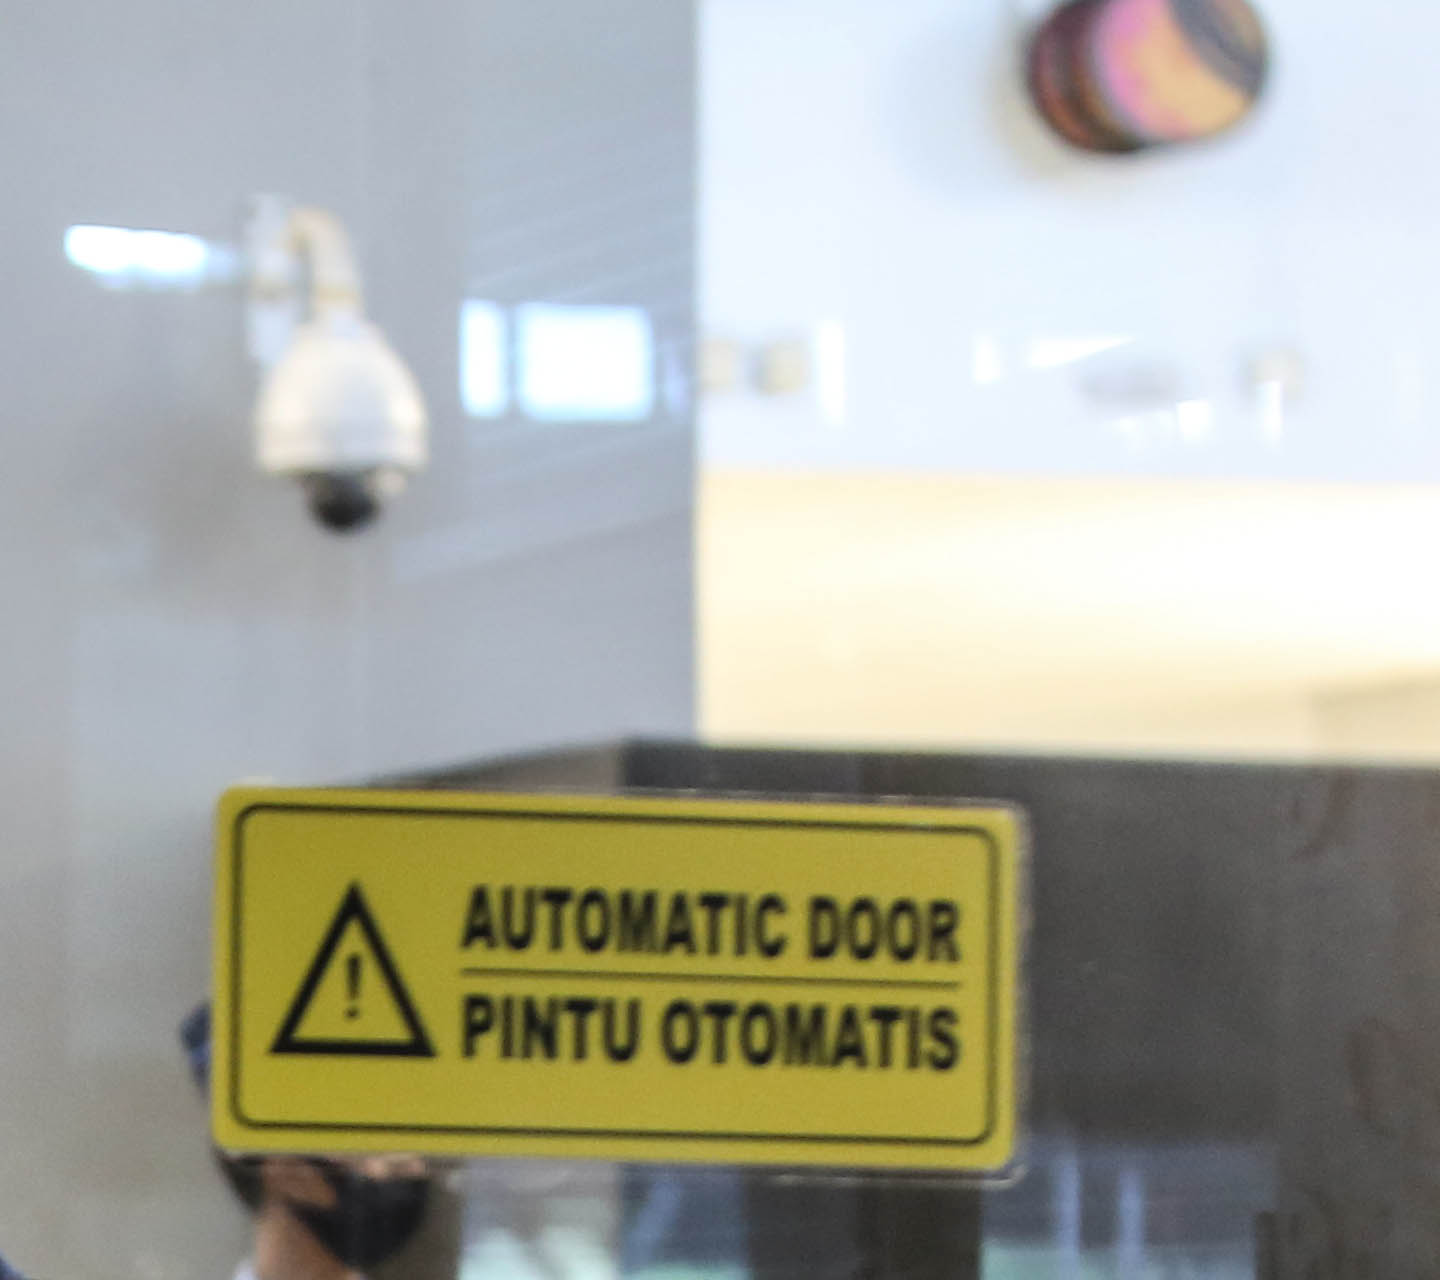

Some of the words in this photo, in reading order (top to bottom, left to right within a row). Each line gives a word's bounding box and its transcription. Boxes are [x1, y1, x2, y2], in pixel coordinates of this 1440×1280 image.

[459, 884, 788, 960] AUTOMATIC
[807, 894, 961, 964] DOOR
[460, 992, 643, 1065] PINTU
[659, 998, 961, 1073] OTOMATIS
